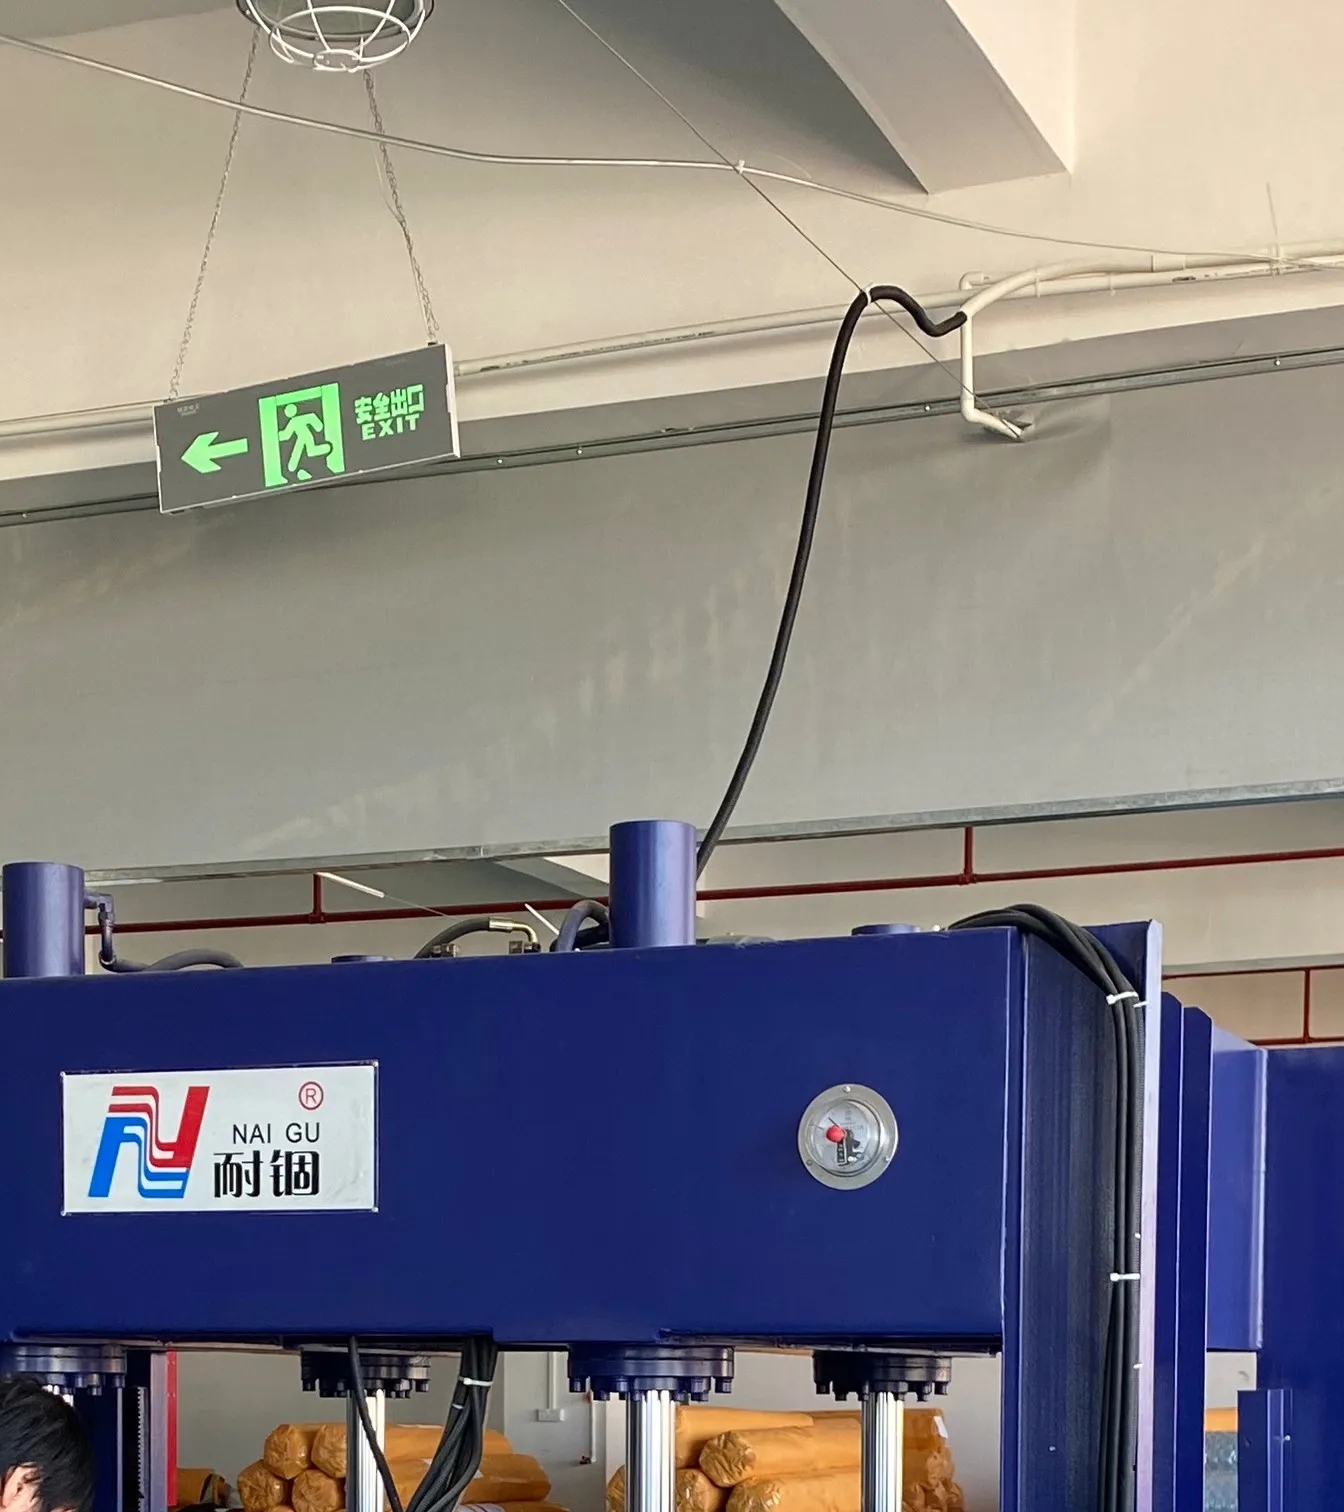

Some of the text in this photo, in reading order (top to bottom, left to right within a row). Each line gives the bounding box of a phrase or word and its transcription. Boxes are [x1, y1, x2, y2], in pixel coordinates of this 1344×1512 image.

[354, 384, 425, 424] 安全出口
[361, 413, 420, 441] EXIT
[232, 1121, 320, 1145] NAI GU
[213, 1149, 320, 1199] 耐锢
